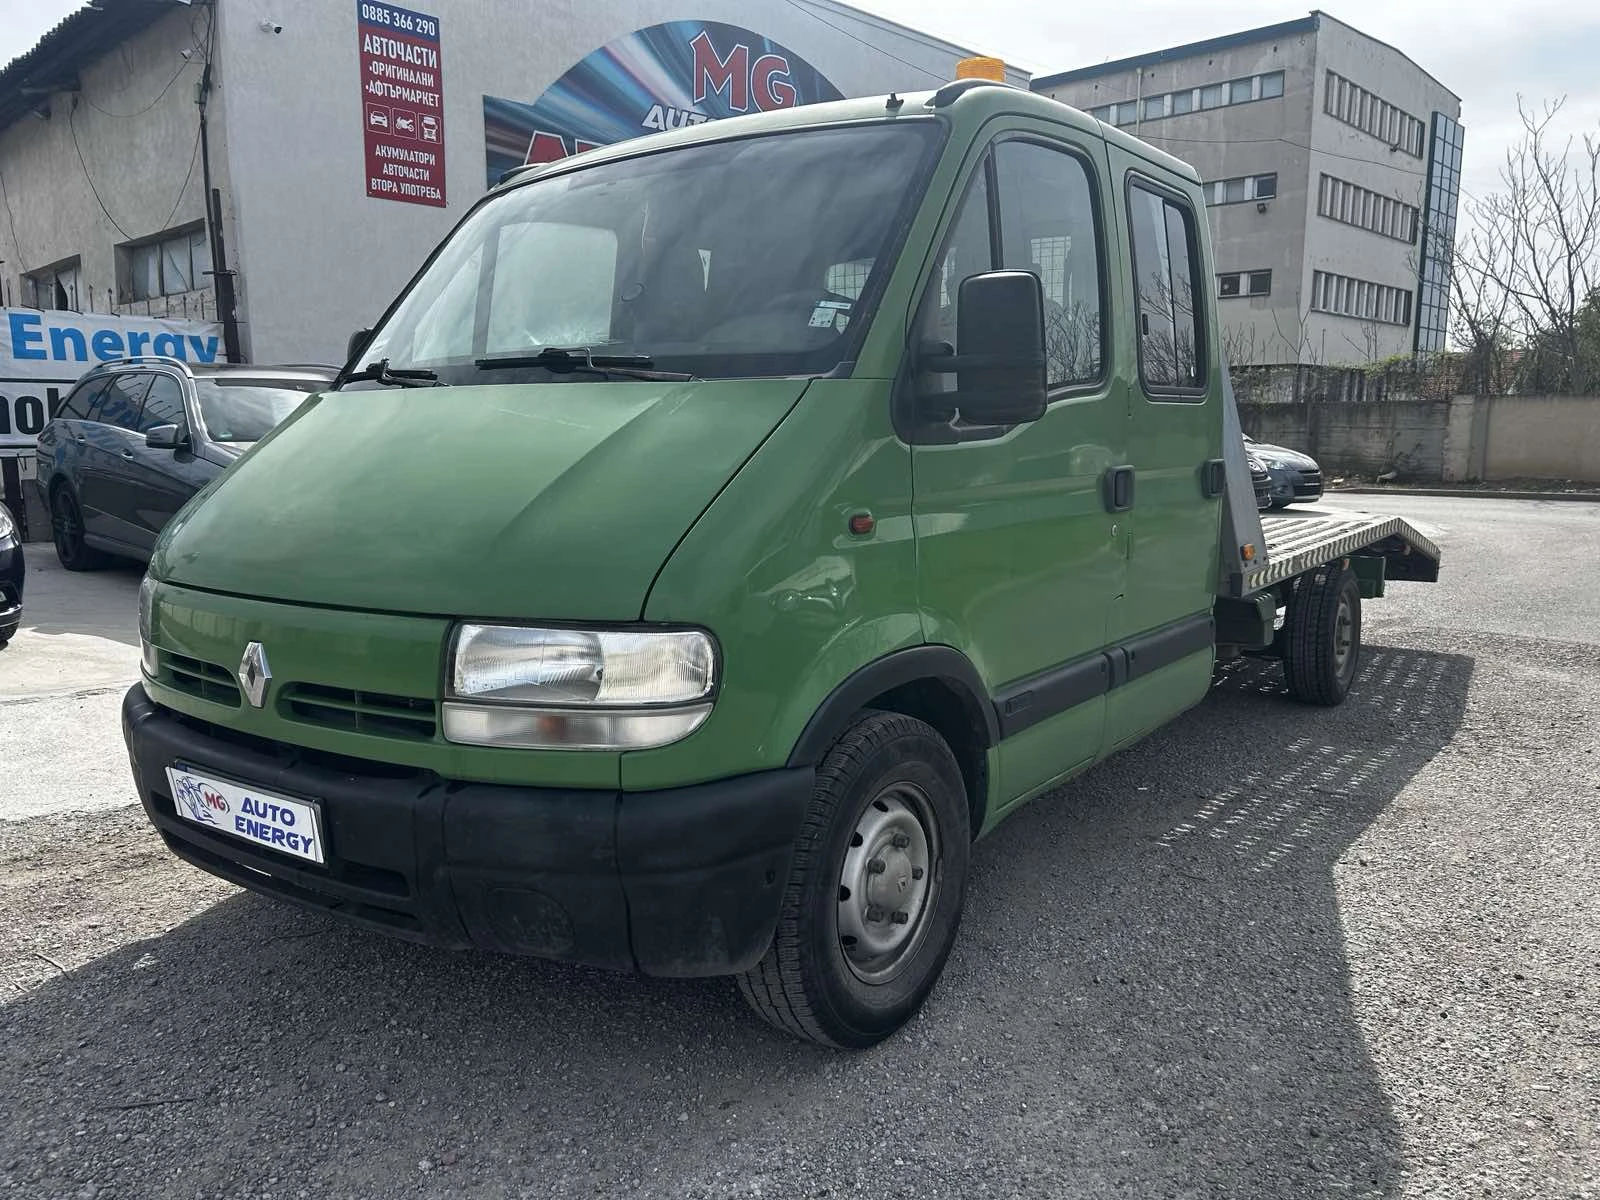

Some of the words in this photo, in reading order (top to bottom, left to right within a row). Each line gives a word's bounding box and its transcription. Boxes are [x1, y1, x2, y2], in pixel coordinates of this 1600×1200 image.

[362, 4, 390, 24] 0885
[394, 12, 413, 31] 366
[416, 18, 436, 36] 290
[364, 34, 437, 69] АВТОЧАСТИ
[690, 31, 797, 112] MG
[375, 144, 436, 166] АКУМУЛАТОРИ
[382, 162, 430, 182] АВТОЧАСТИ
[371, 178, 398, 194] ВТОРА
[400, 182, 441, 200] УПОТРЕБА
[204, 790, 226, 811] MG
[241, 797, 295, 827] AUTO
[234, 815, 314, 854] ENERGY
